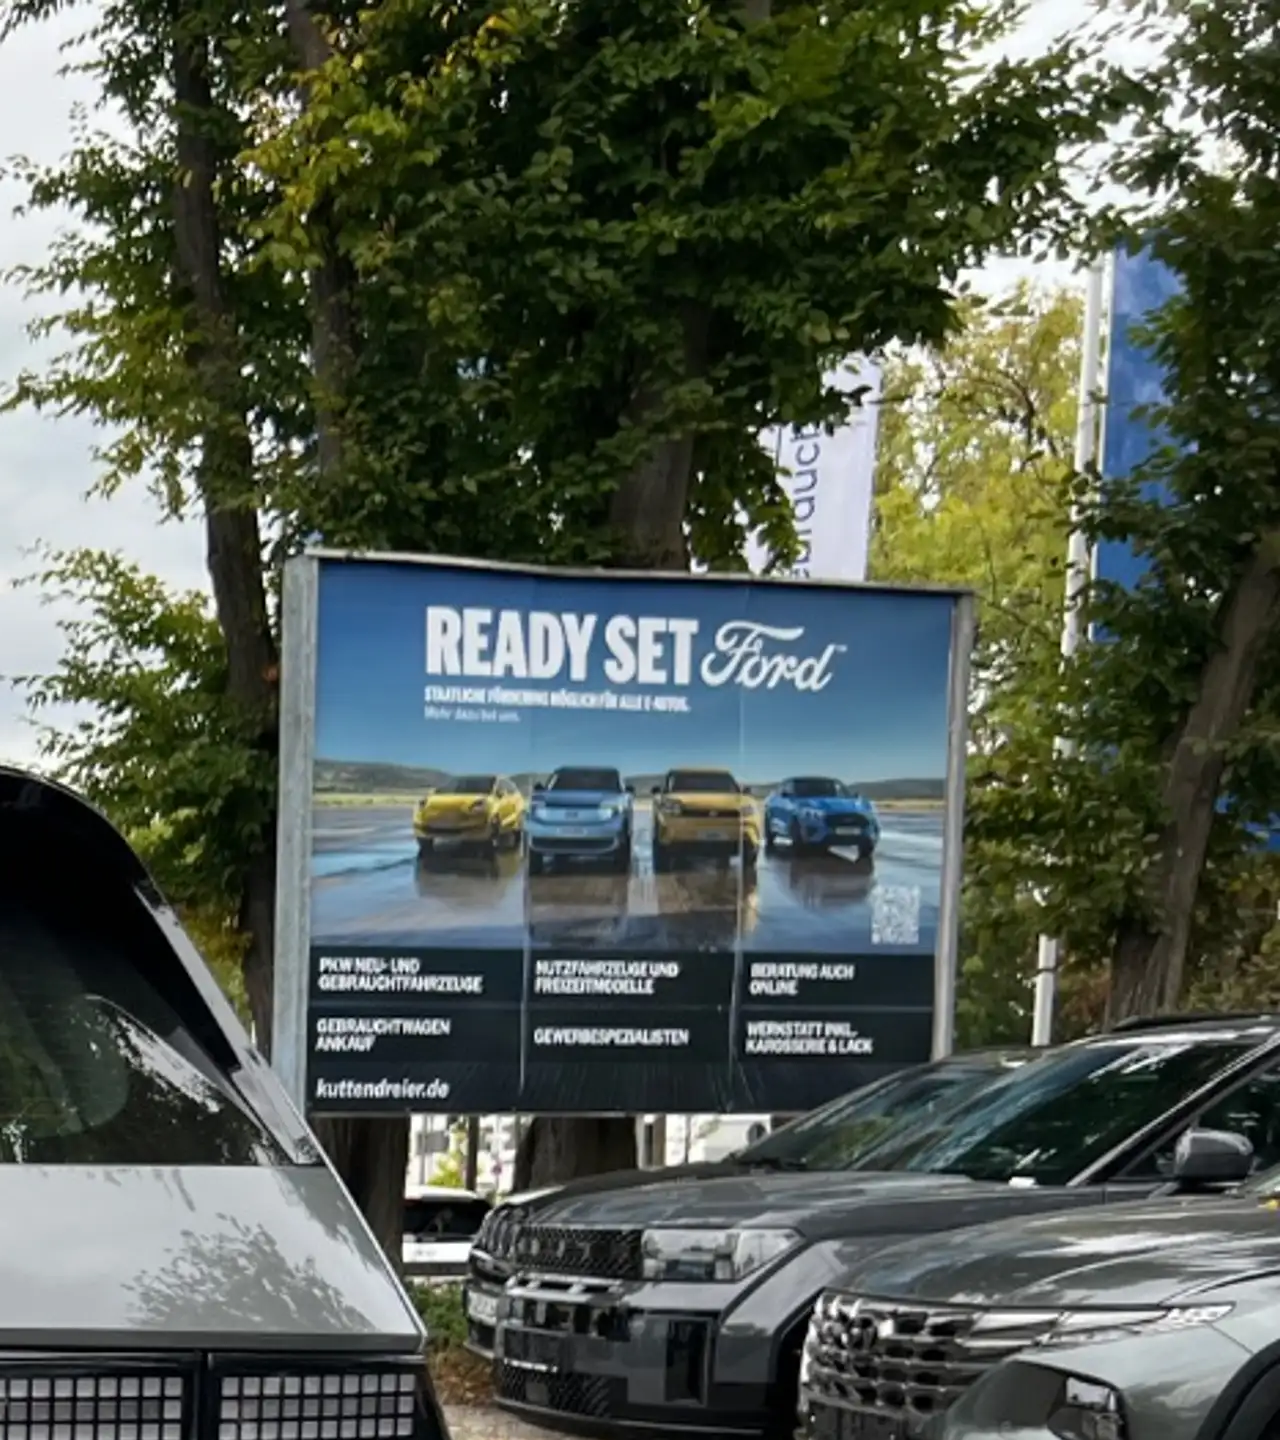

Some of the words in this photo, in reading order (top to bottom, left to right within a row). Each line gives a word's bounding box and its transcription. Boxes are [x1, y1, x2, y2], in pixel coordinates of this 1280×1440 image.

[426, 605, 598, 682] READY
[604, 615, 699, 685] SET
[700, 619, 836, 692] Ford
[318, 956, 353, 973] PKW
[391, 957, 421, 974] UND
[535, 959, 648, 978] NUTZFAHRZEUGE
[649, 961, 680, 978] UND
[750, 962, 818, 979] BERATUNG
[819, 963, 855, 980] AUCH
[317, 974, 484, 993] GEBRAUCHTFAHRZEUGE
[534, 977, 655, 994] FREIZEITMODELLE
[749, 979, 799, 996] ONLINE
[316, 1018, 452, 1036] GEBRAUCHTWAGEN
[534, 1026, 690, 1046] GEWERBESPEZIALISTEN
[746, 1021, 823, 1038] WERKSTATT
[314, 1035, 377, 1052] ANKAUF
[745, 1038, 825, 1054] KAROSSERIE
[827, 1039, 837, 1054] &
[838, 1038, 874, 1055] LACK
[315, 1077, 450, 1098] kuttendreier.de
